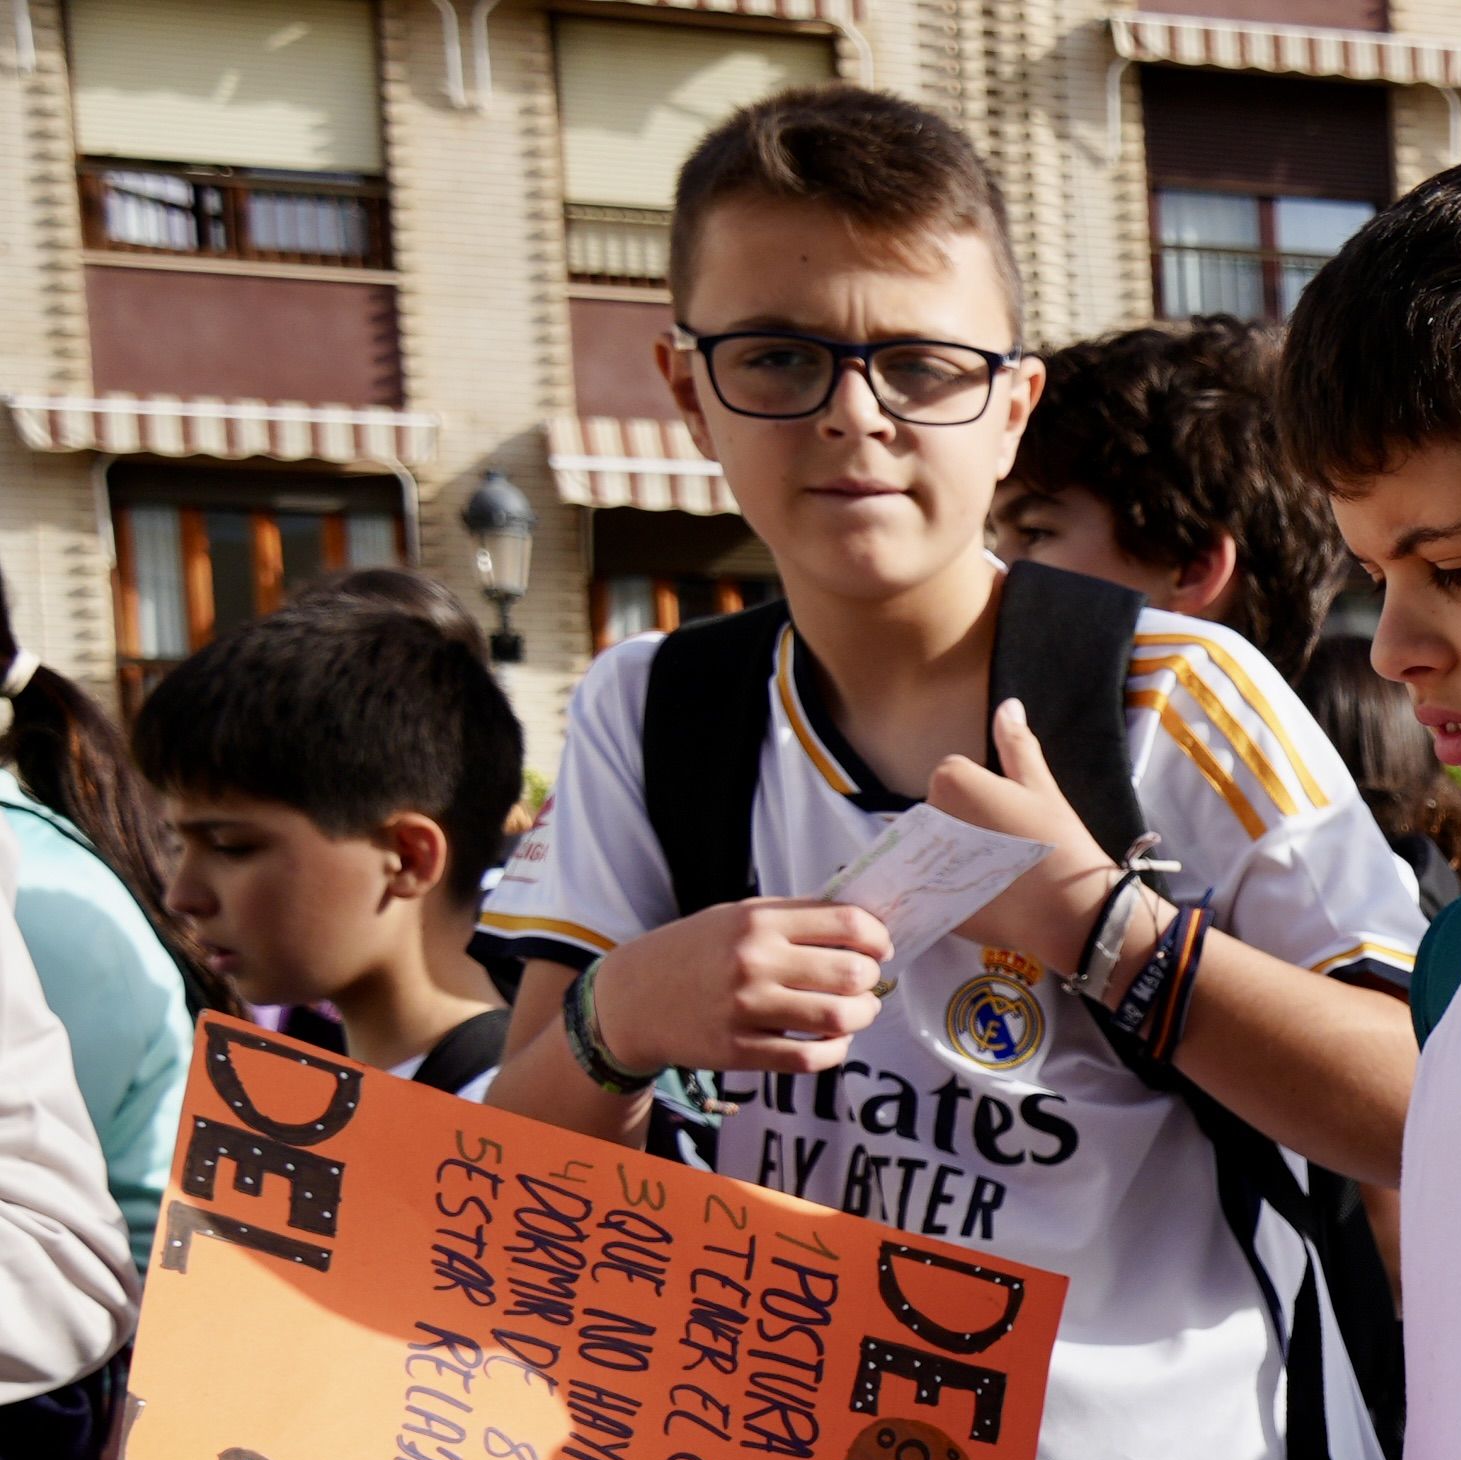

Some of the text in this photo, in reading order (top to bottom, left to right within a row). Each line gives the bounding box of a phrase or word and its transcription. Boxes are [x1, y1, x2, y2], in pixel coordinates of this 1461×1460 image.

[161, 1022, 364, 1274] DEL
[431, 1158, 505, 1307] ESTAR
[504, 1173, 594, 1326] DORMIR
[591, 1209, 673, 1297] QUE
[483, 1328, 562, 1397] DE
[578, 1308, 657, 1373] NO
[679, 1235, 757, 1375] TENER
[740, 1258, 840, 1459] POSTURA
[664, 1384, 733, 1442] EL
